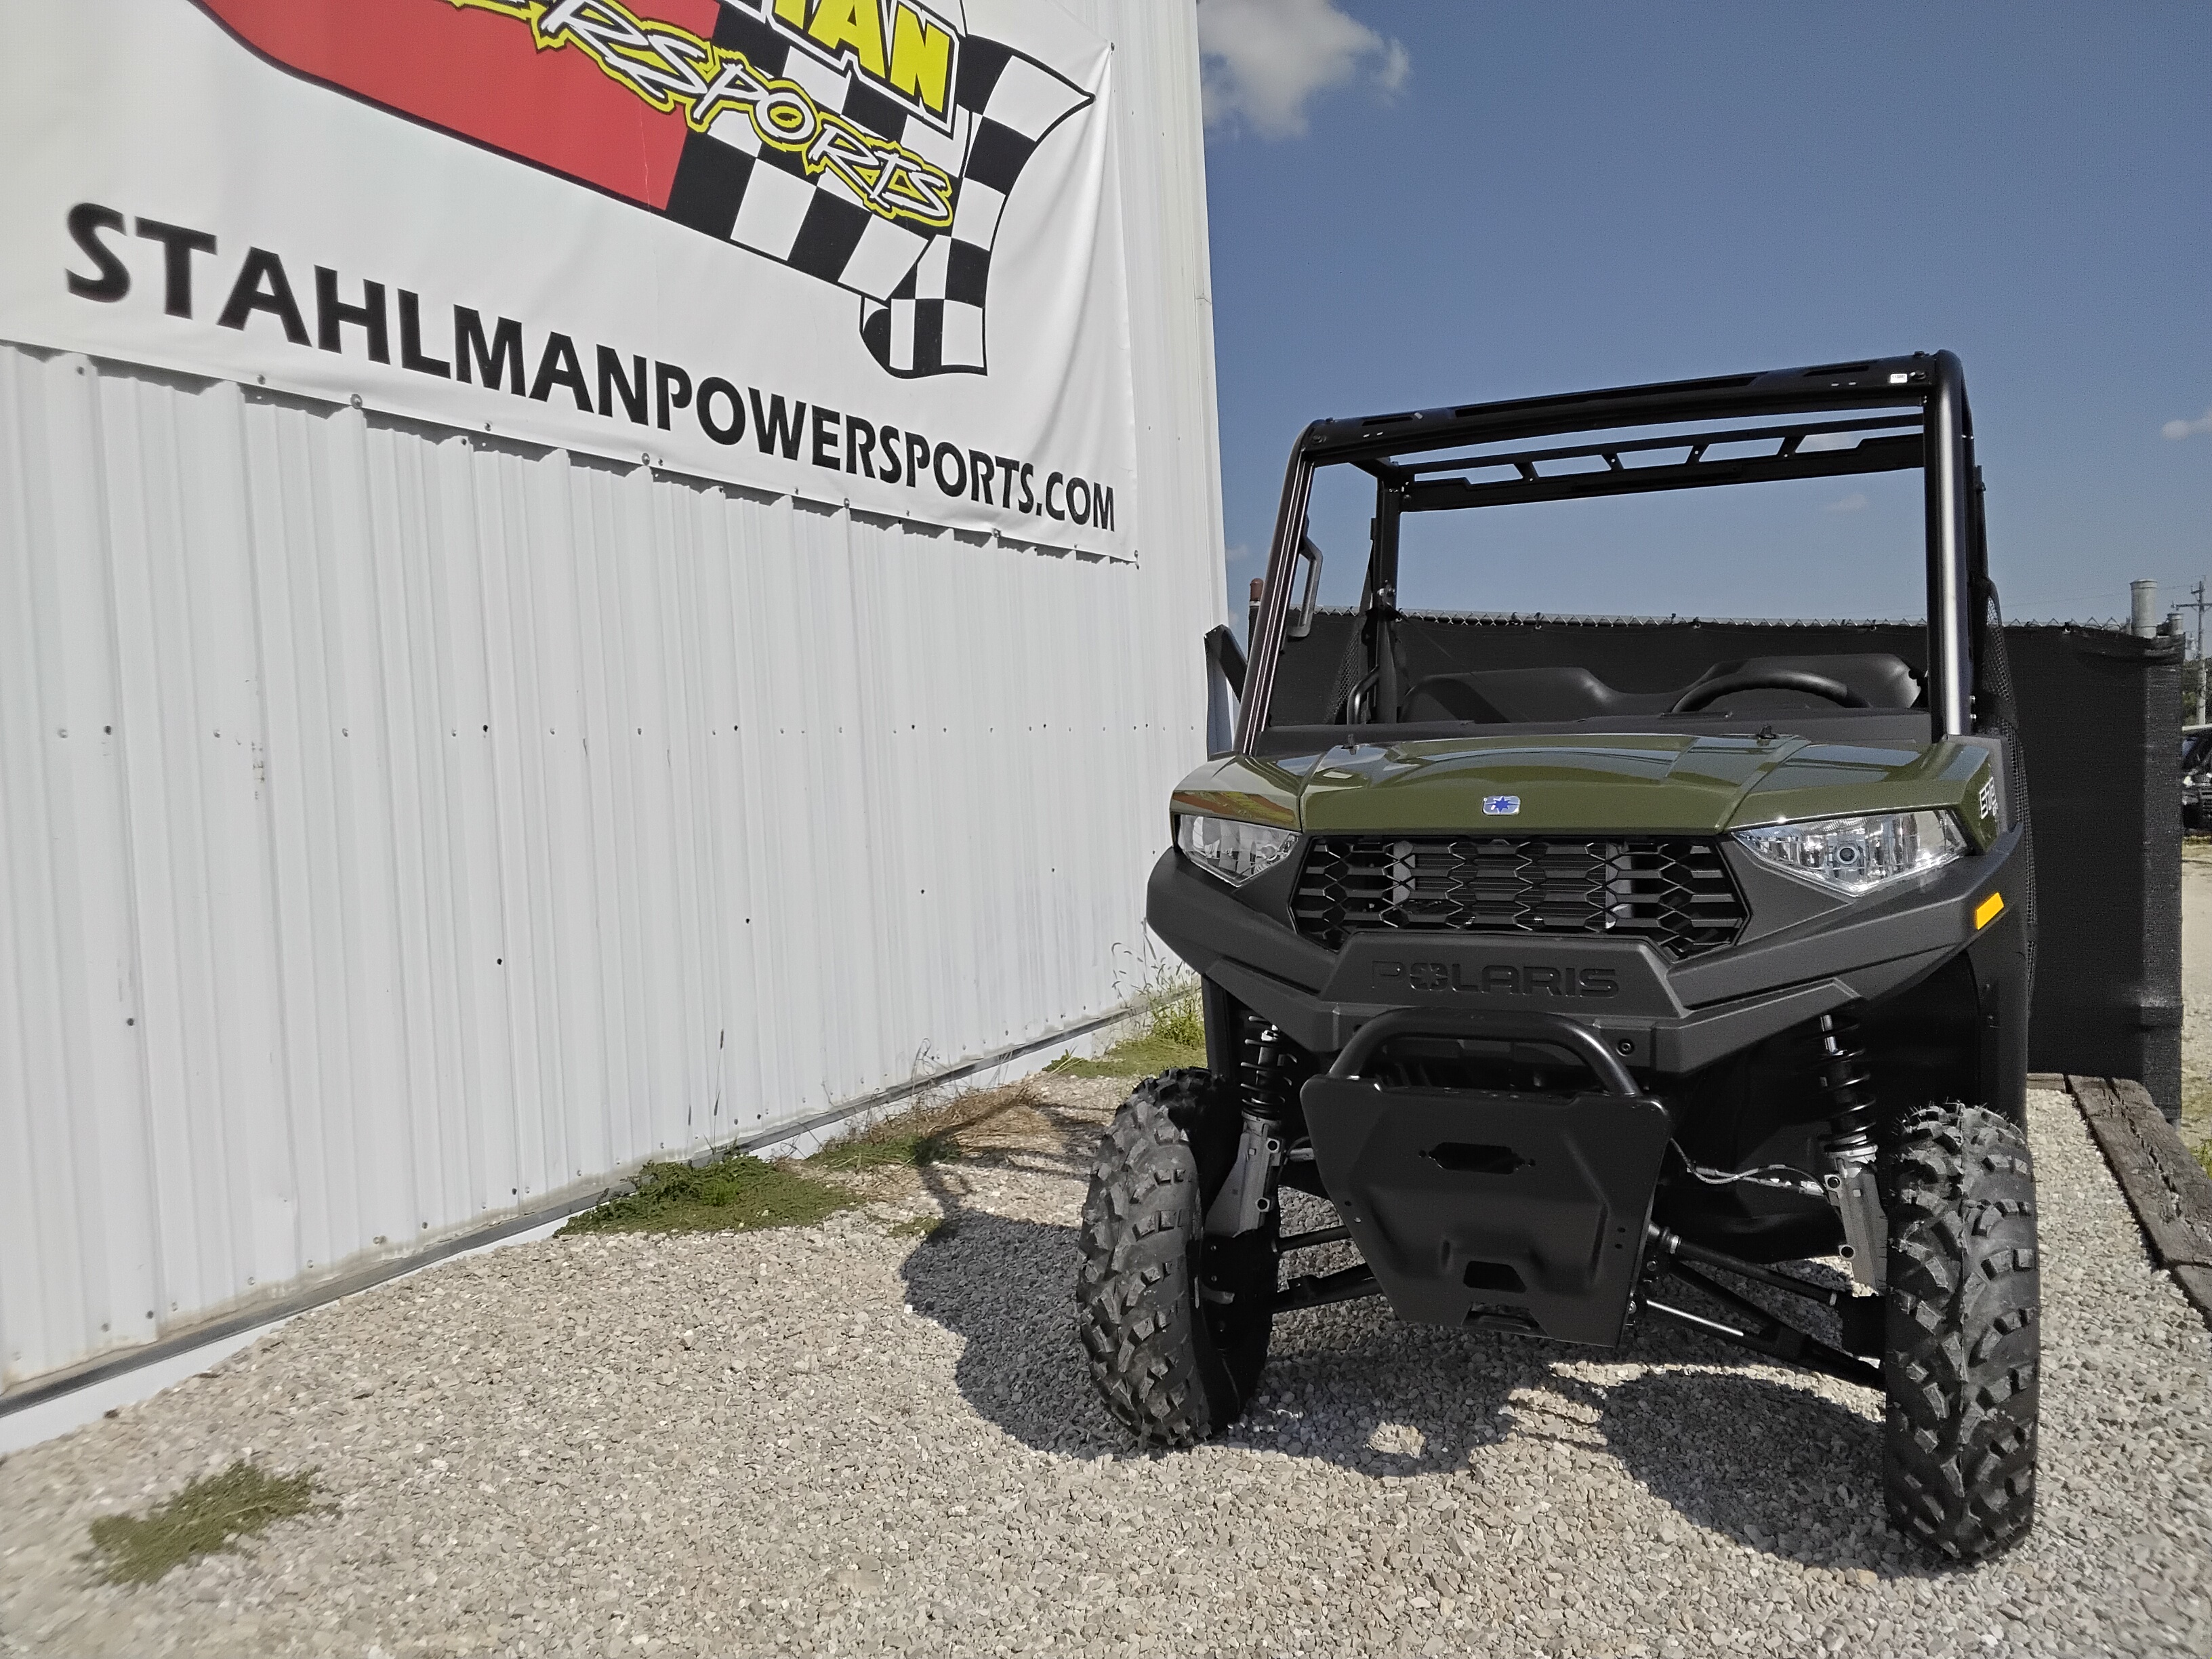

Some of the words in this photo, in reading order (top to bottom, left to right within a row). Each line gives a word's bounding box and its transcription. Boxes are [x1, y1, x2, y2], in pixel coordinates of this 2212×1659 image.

[531, 0, 951, 226] RSPORTS
[65, 202, 1115, 532] STAHLMANPOWERSPORTS.COM
[1372, 960, 1619, 998] POLARIS
